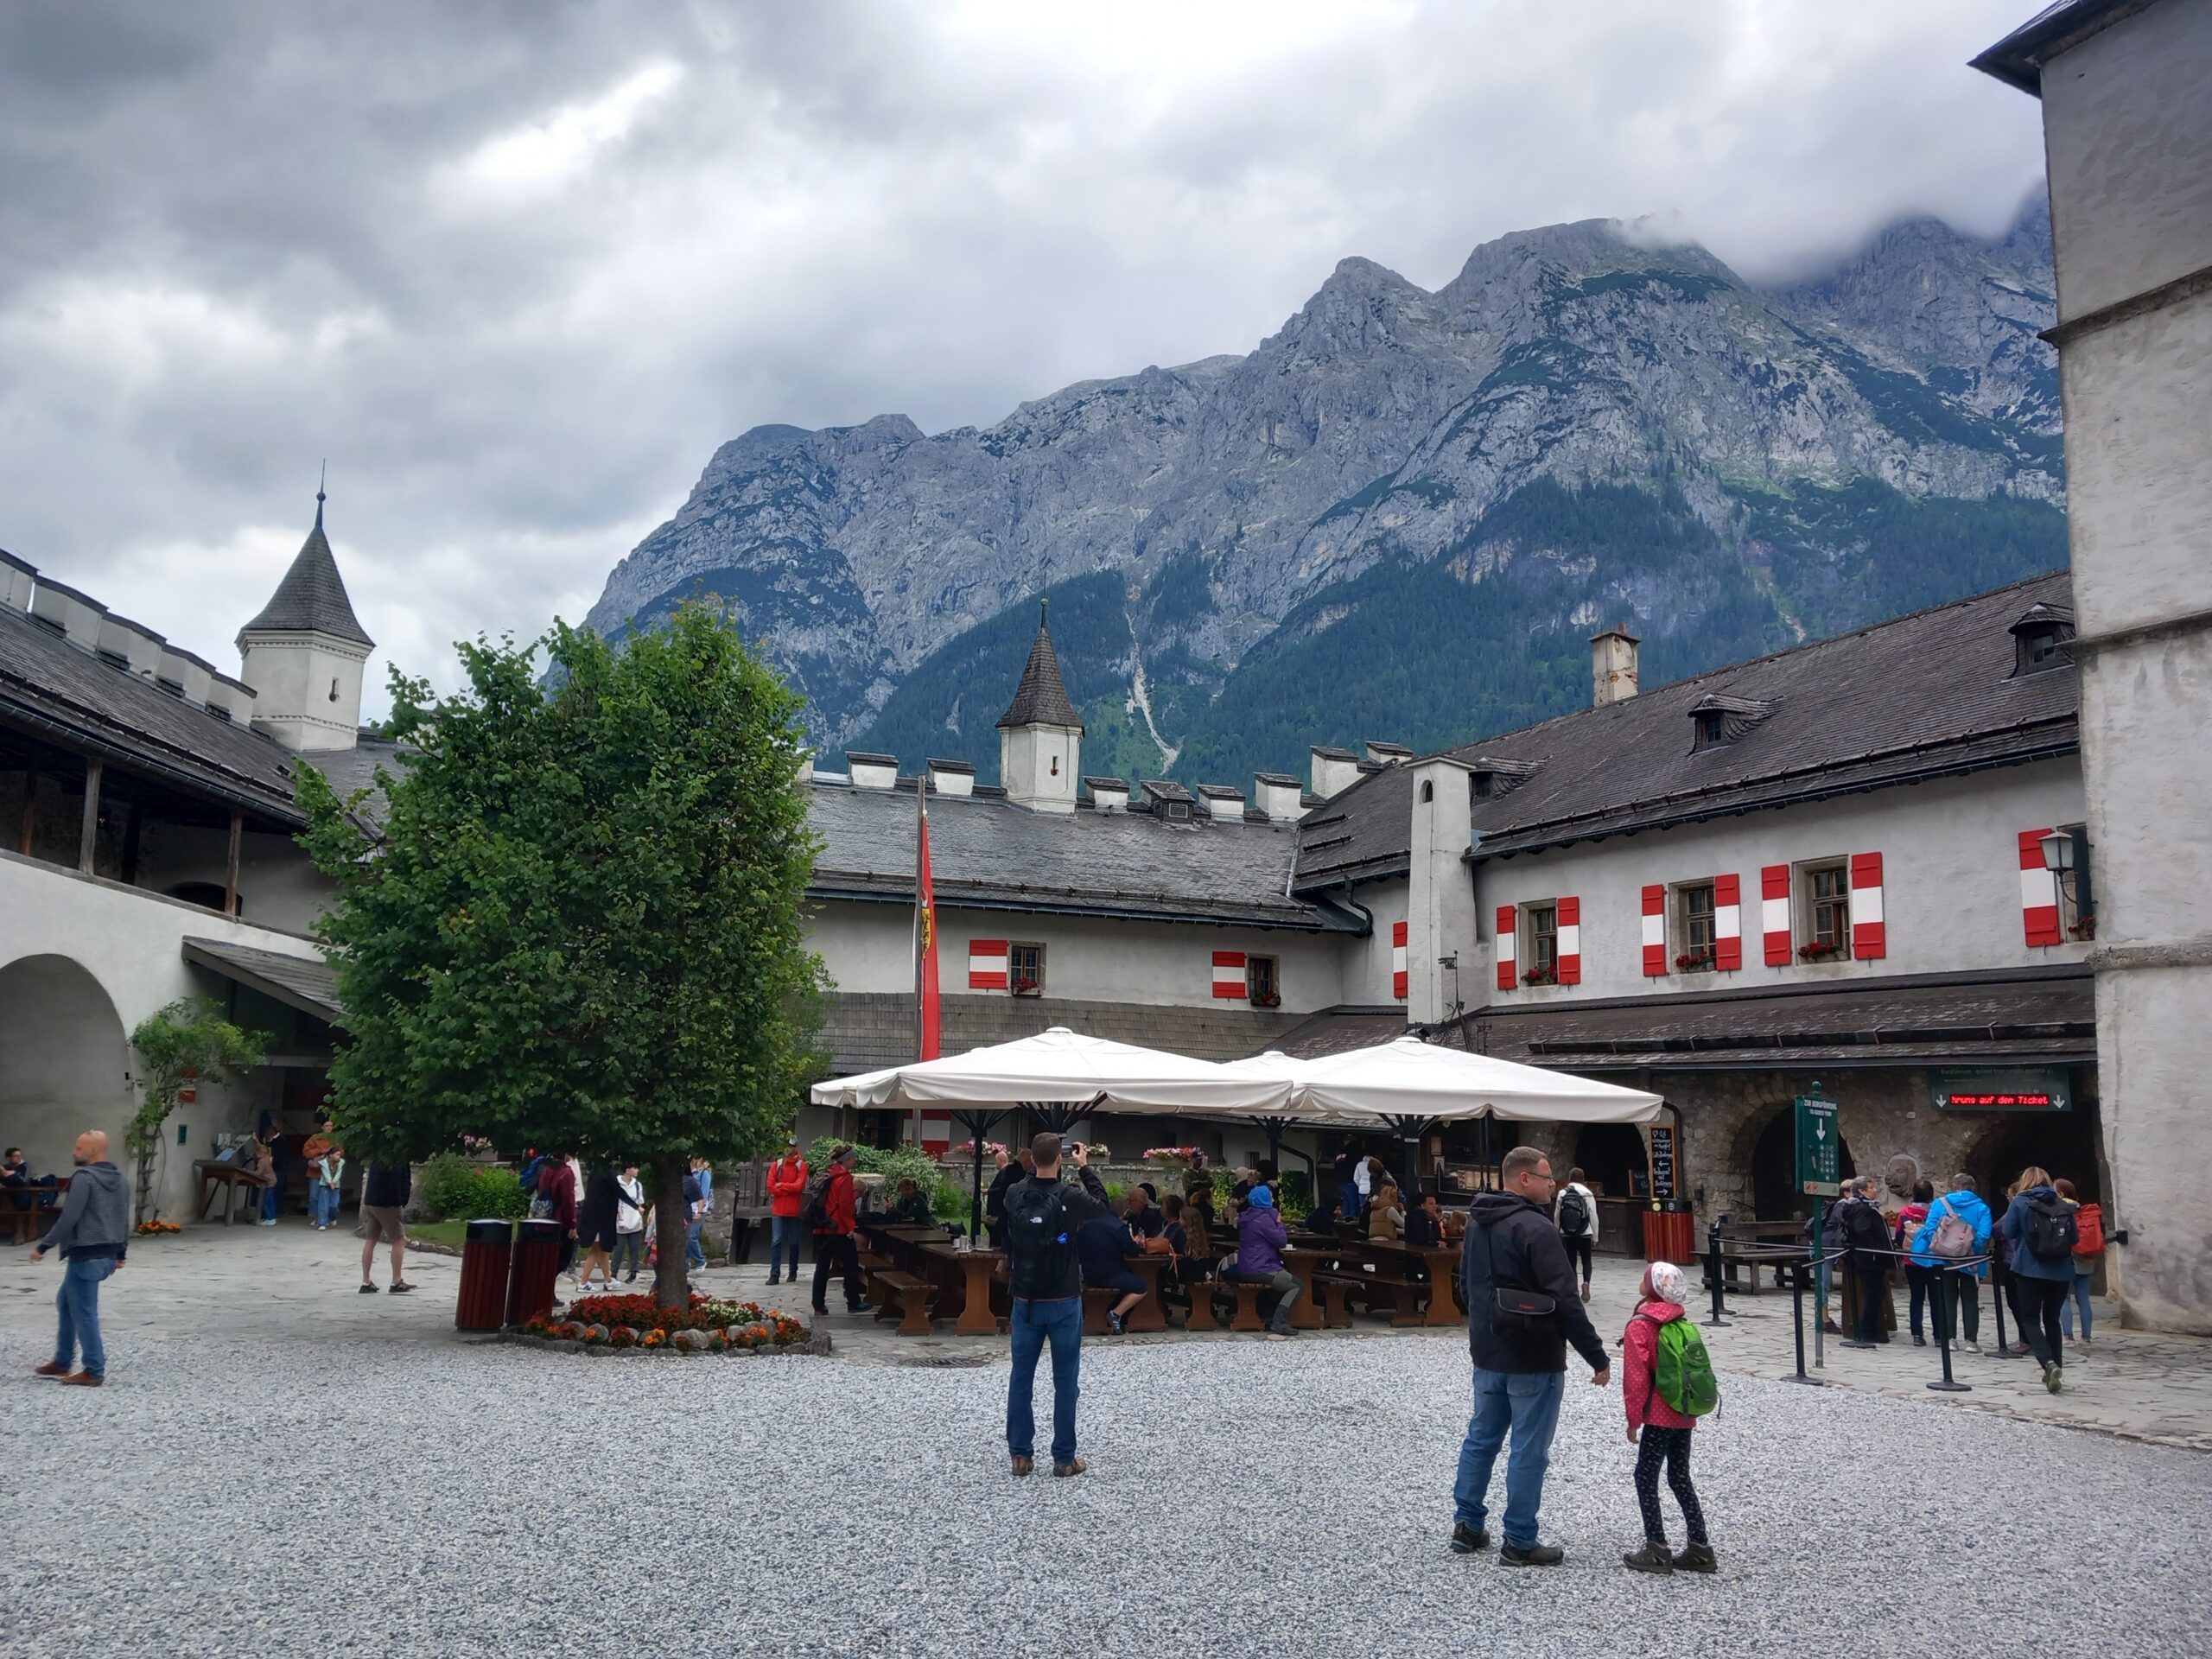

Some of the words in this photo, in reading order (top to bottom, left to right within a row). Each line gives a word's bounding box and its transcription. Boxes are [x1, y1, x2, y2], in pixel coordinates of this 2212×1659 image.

[1979, 1096, 1995, 1104] auf
[1998, 1096, 2014, 1104] den
[2018, 1096, 2049, 1104] Ticket
